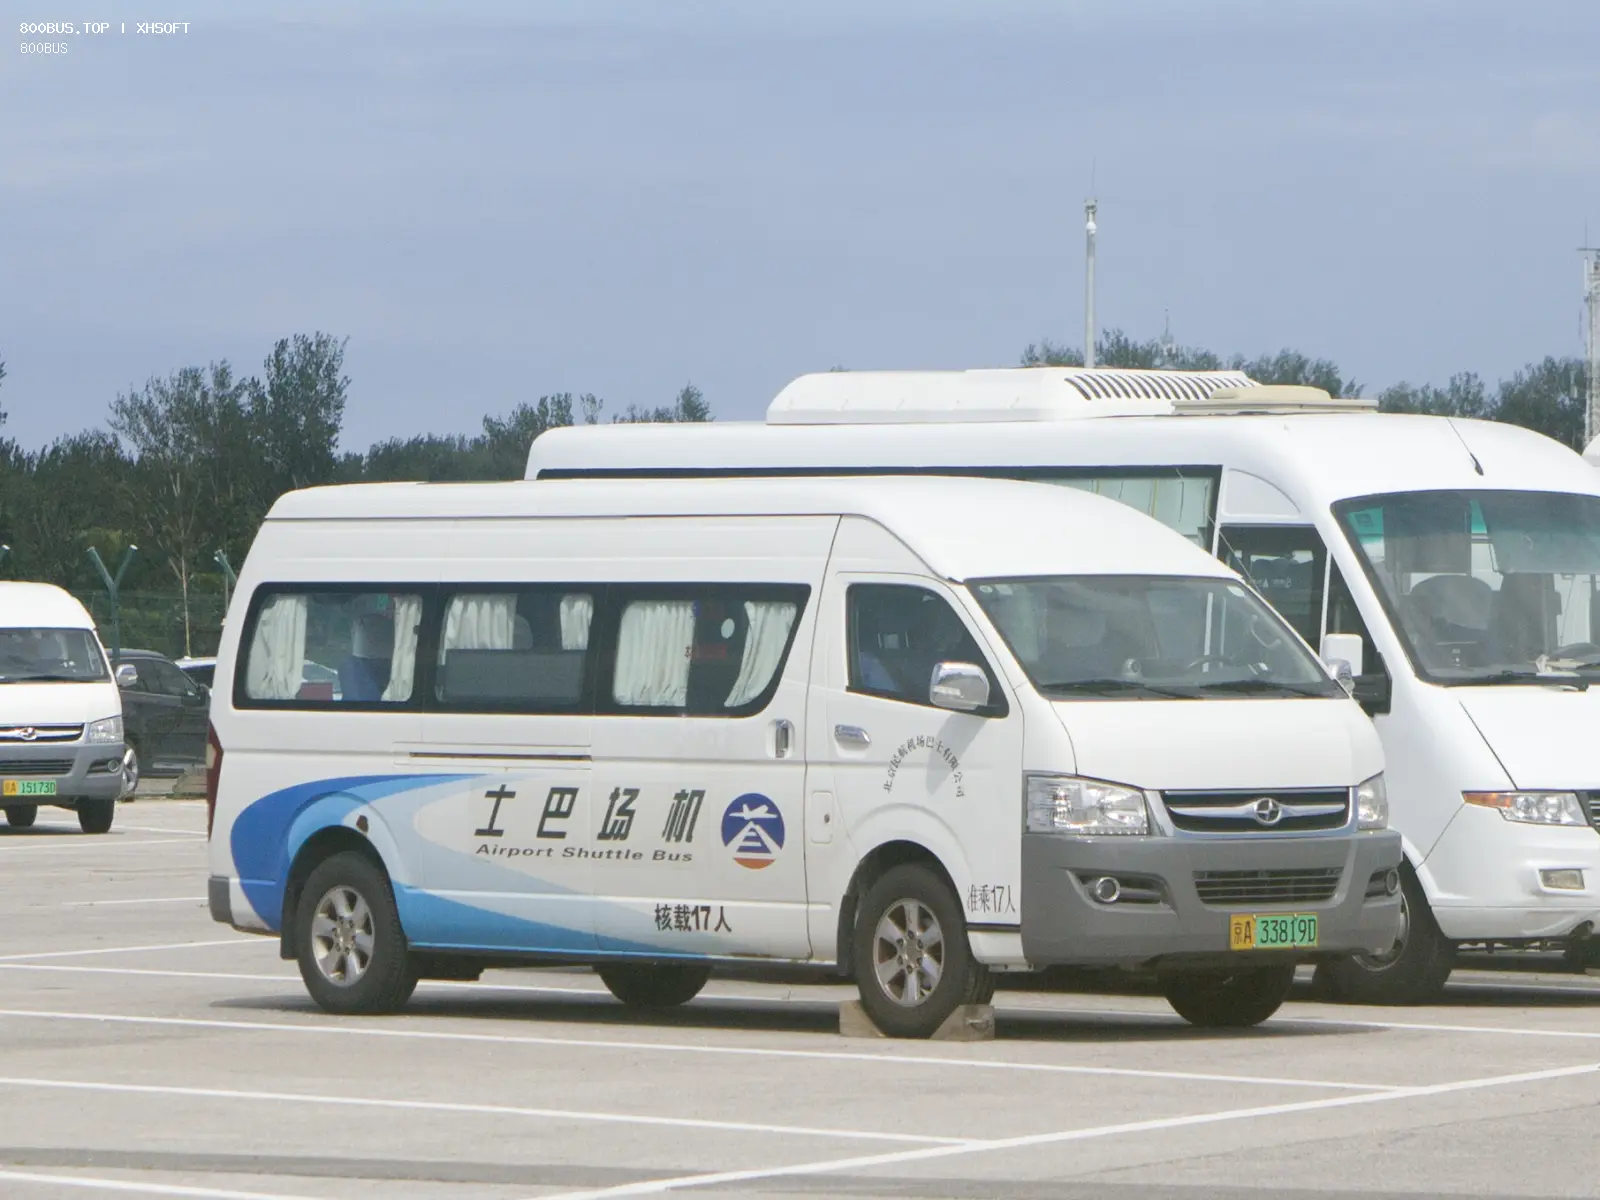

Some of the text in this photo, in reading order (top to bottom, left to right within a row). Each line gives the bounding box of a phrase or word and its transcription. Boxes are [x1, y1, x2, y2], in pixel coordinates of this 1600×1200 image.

[476, 843, 693, 862] Airport Shuttle Bus
[654, 902, 732, 932] 核载17人
[1260, 918, 1317, 944] 33819D
